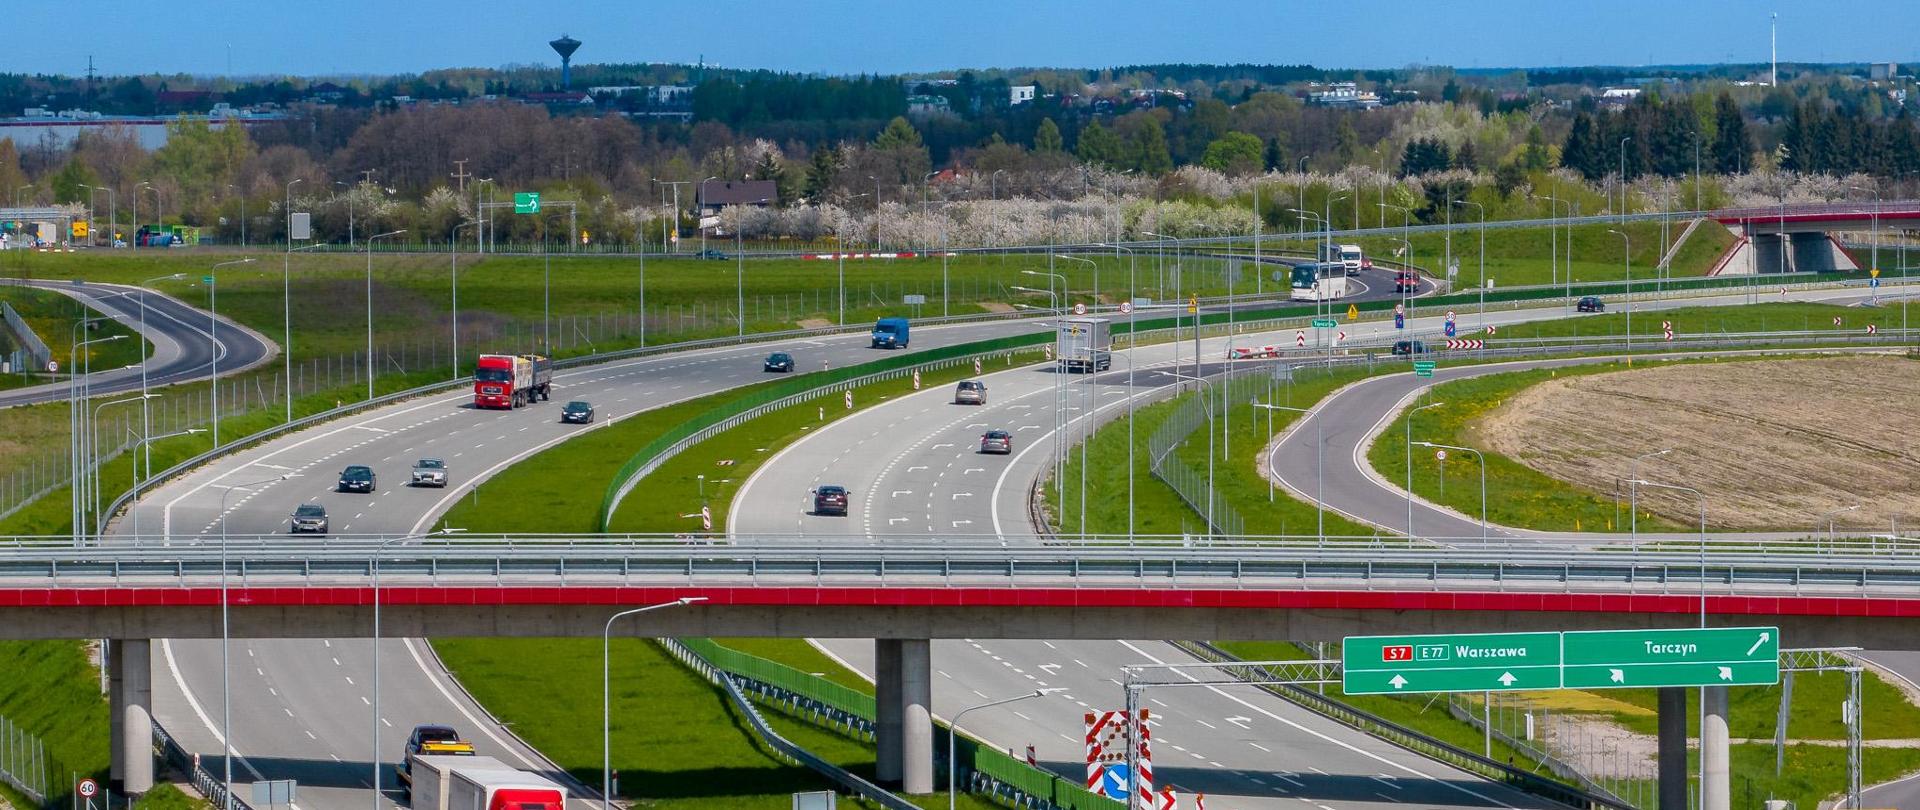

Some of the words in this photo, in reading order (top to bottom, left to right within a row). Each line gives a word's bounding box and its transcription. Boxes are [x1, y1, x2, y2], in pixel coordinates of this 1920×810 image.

[1455, 645, 1527, 658] Warszawa
[1644, 640, 1697, 657] Tarczyn
[81, 783, 94, 793] 60
